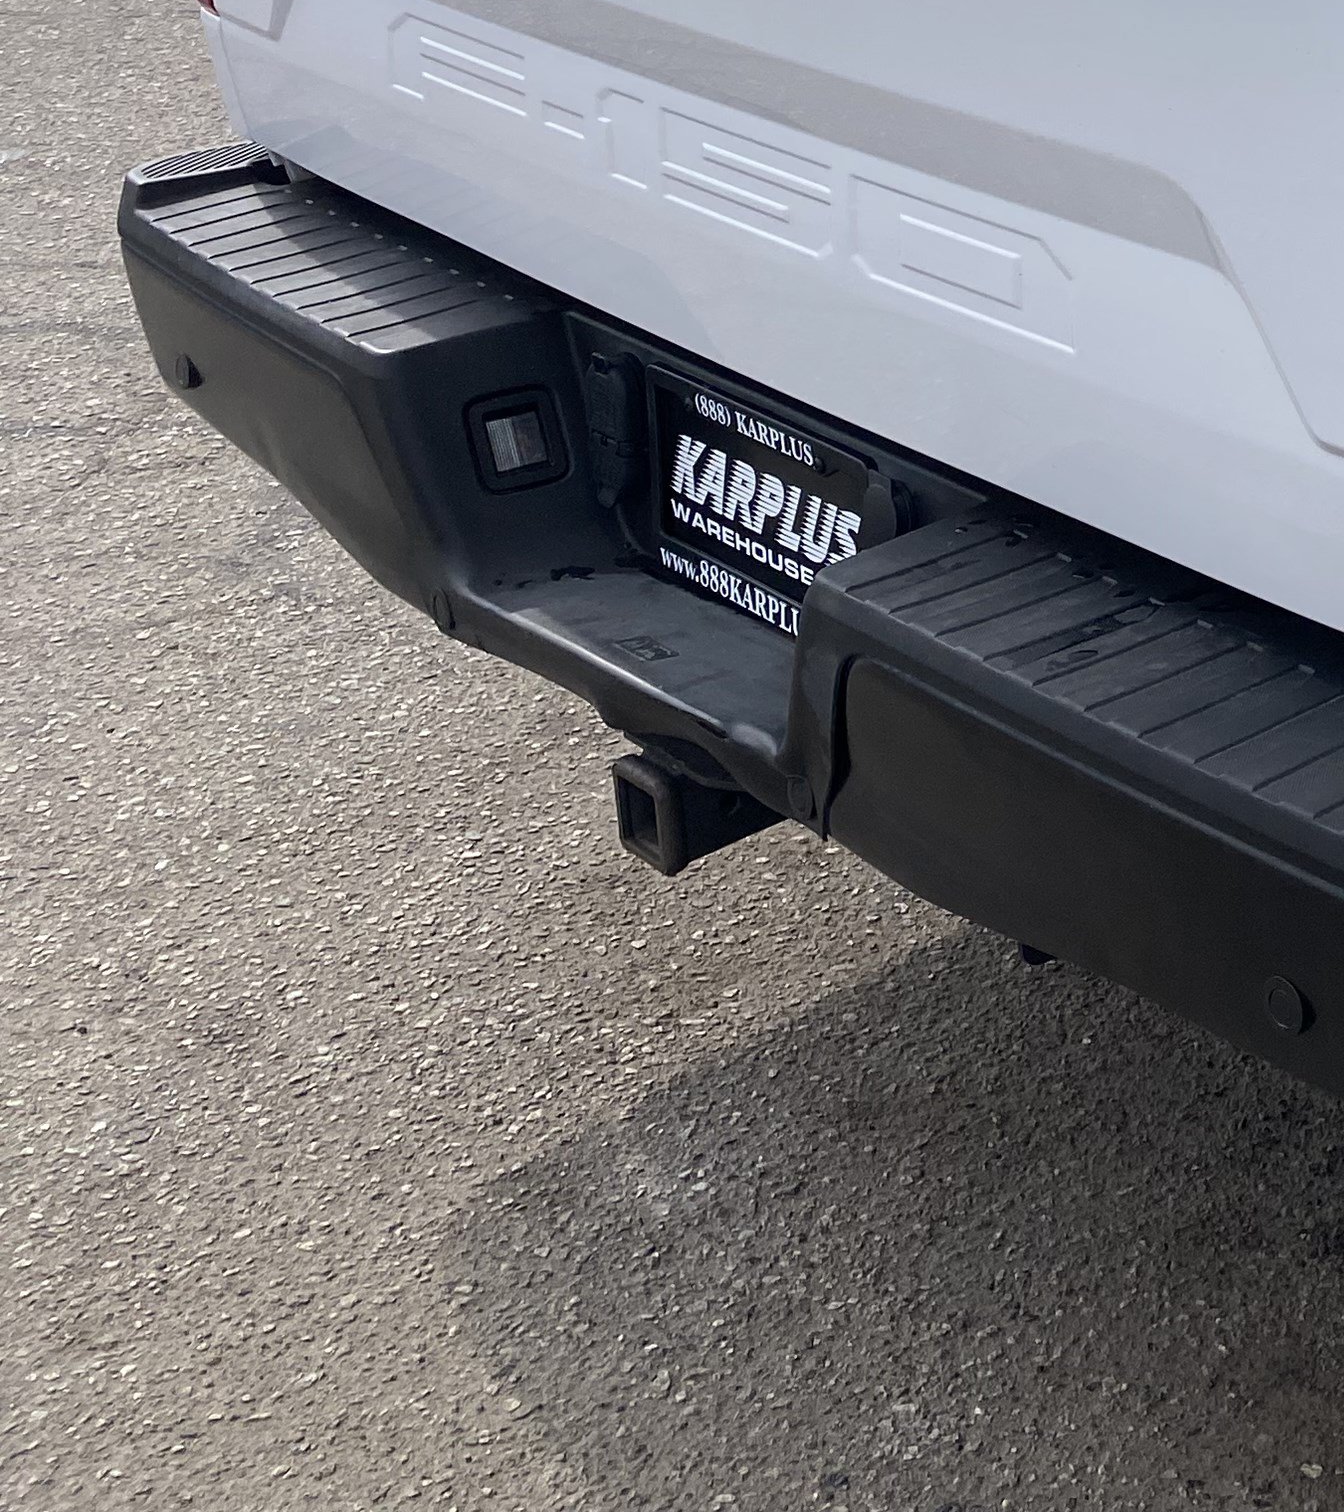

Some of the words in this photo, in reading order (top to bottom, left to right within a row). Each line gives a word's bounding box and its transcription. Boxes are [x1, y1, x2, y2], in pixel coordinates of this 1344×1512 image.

[694, 392, 732, 428] (888)
[735, 410, 815, 467] KARPLUS
[670, 434, 862, 567] KARPLUS
[671, 498, 814, 586] WAREHOUSE
